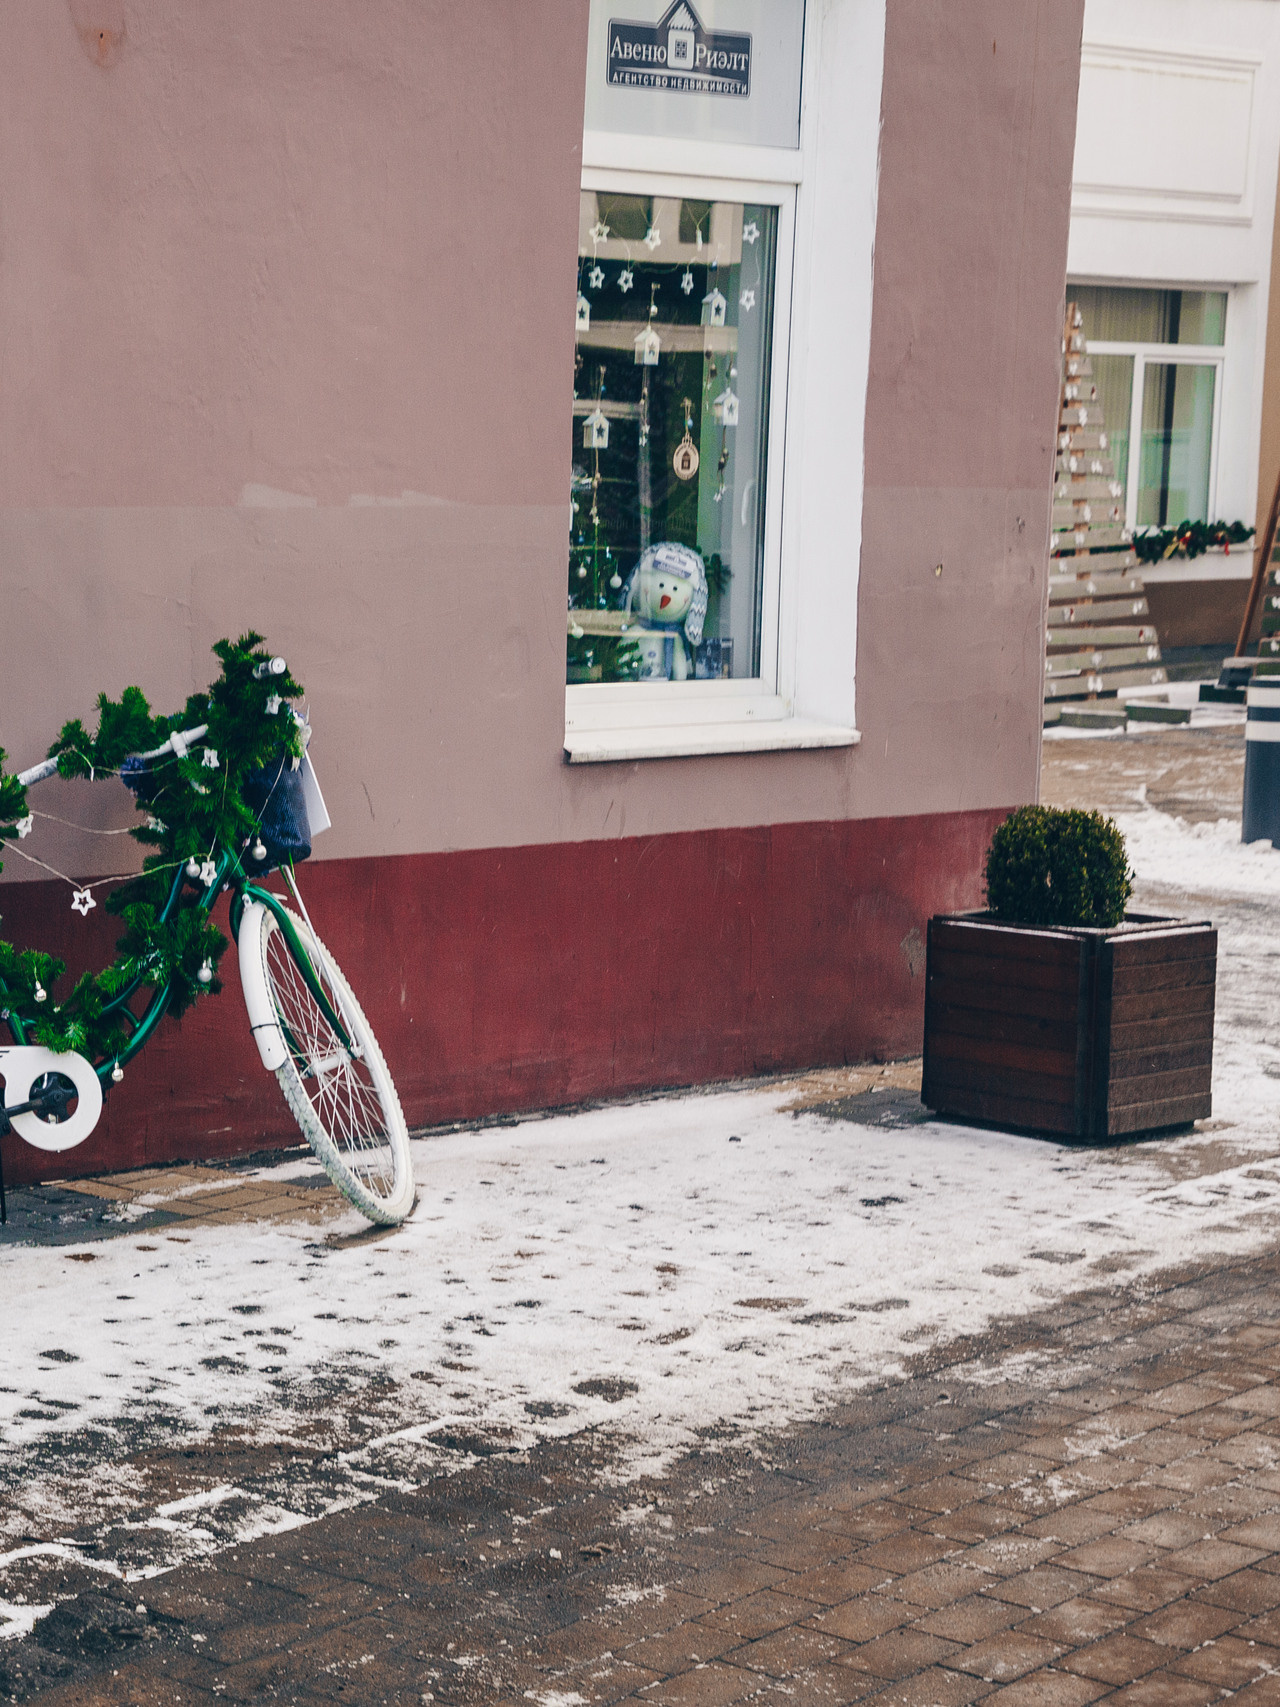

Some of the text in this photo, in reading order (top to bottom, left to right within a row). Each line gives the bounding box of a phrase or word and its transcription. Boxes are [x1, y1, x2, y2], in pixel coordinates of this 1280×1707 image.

[610, 35, 749, 71] Авеню Риэлт
[612, 71, 747, 95] АГЕНТСТВО НЕДВИЖИМОСТИ
